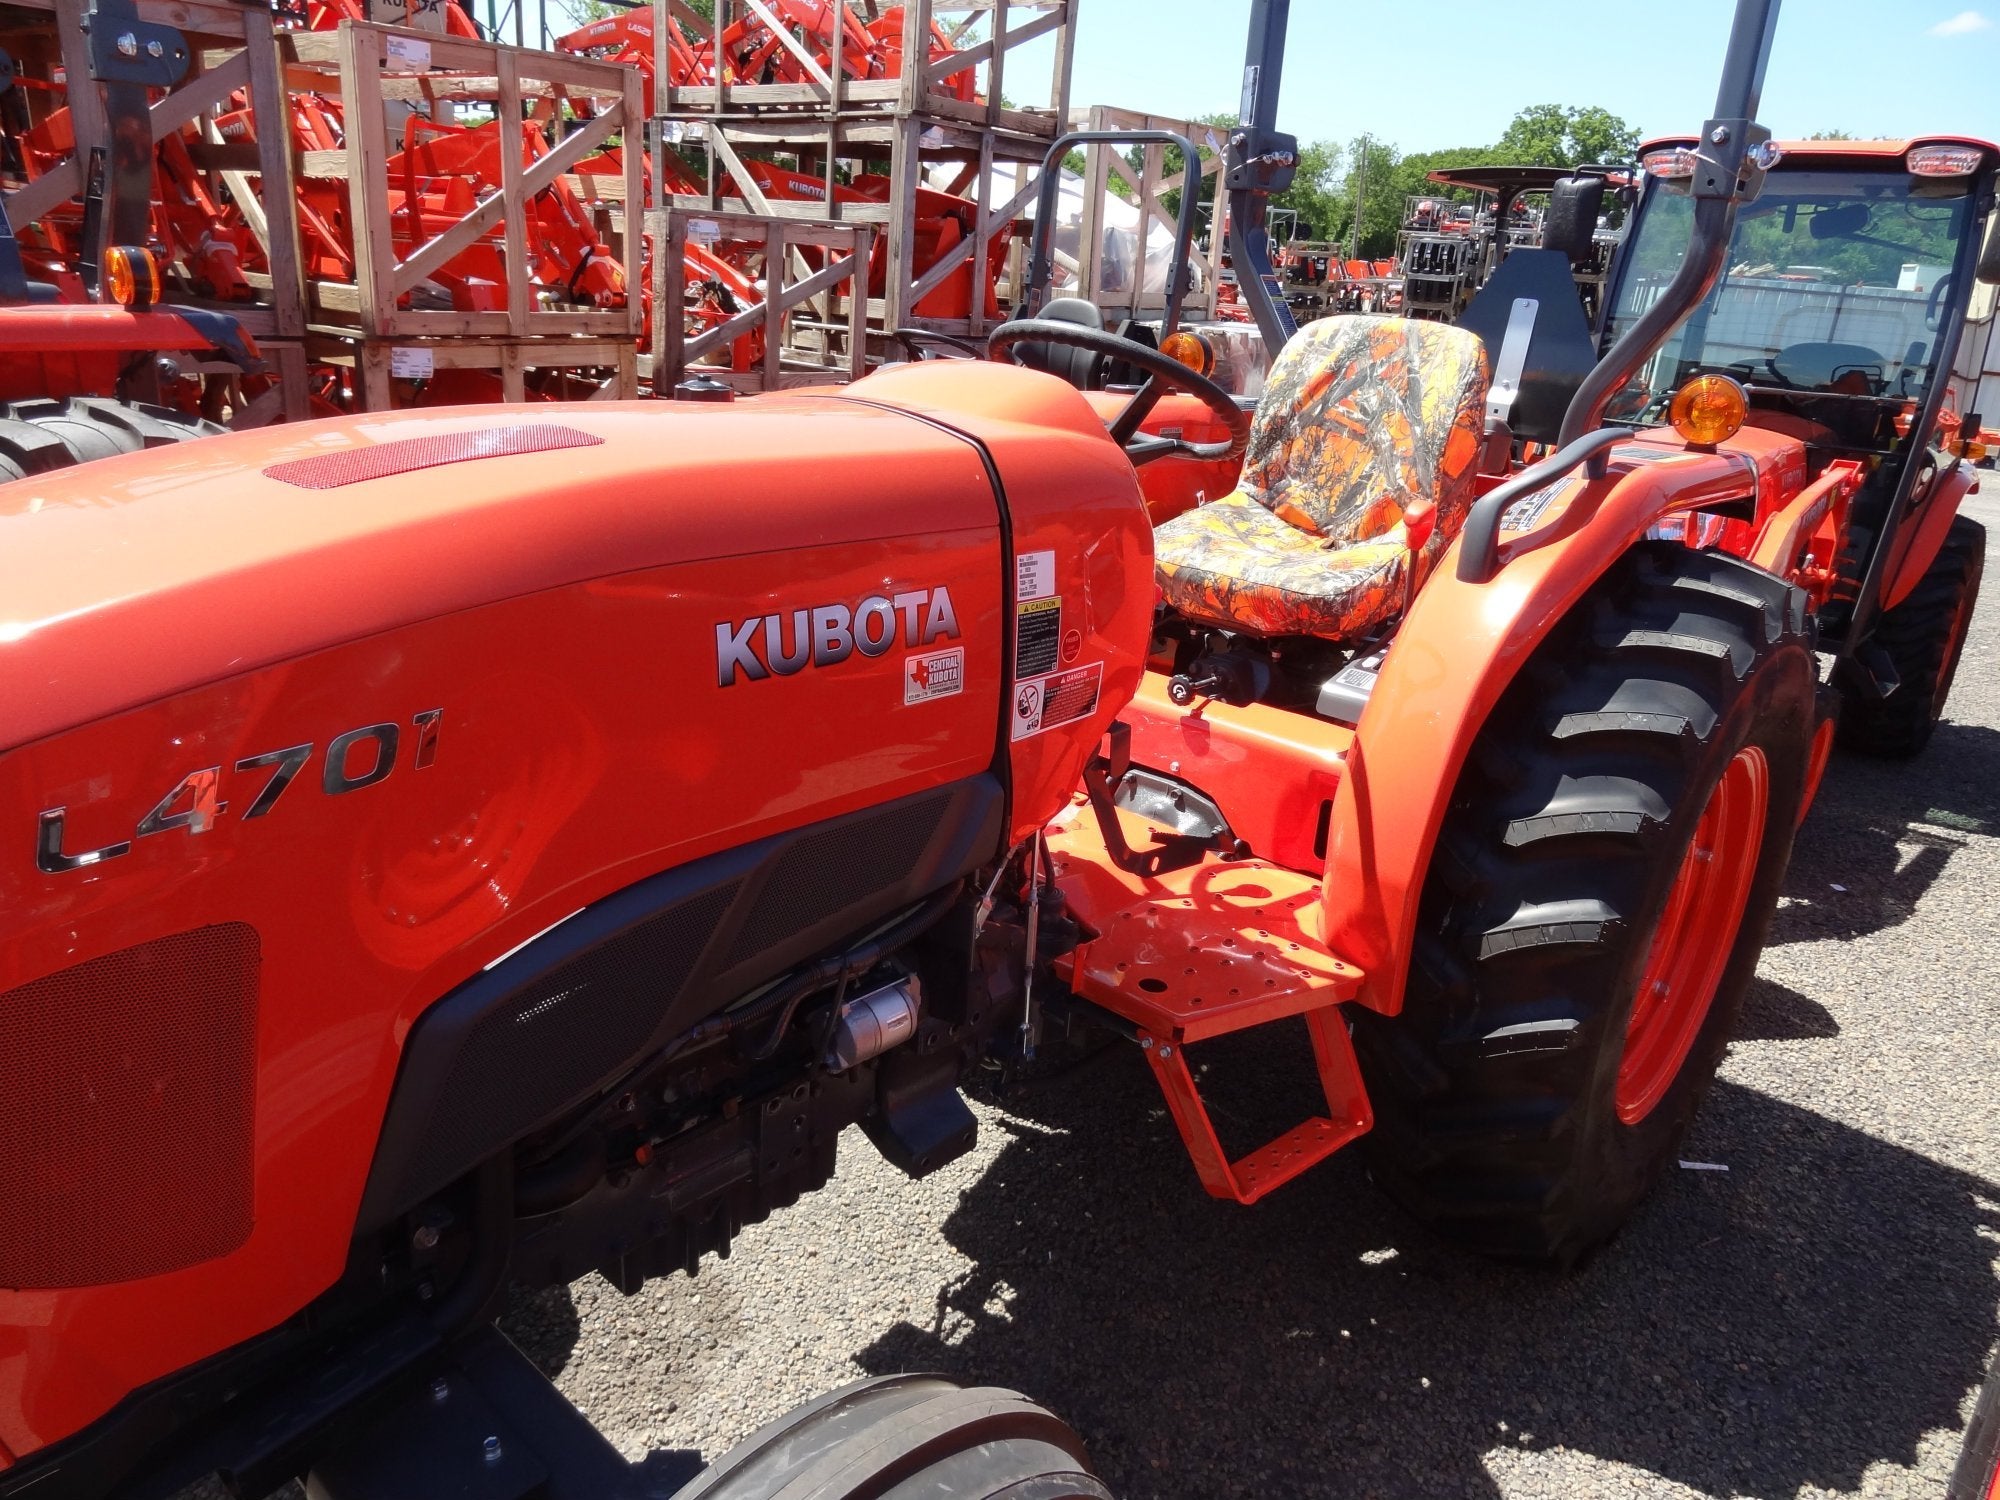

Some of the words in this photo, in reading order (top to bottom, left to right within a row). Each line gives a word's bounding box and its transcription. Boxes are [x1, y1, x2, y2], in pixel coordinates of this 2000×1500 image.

[788, 181, 825, 198] KUBOTA
[1030, 600, 1056, 611] CAUTION
[715, 586, 961, 688] KUBOTA
[928, 656, 958, 673] CENTRAL
[928, 668, 958, 685] KUBOTA
[1066, 670, 1088, 682] DANGER
[36, 708, 444, 874] L4701
